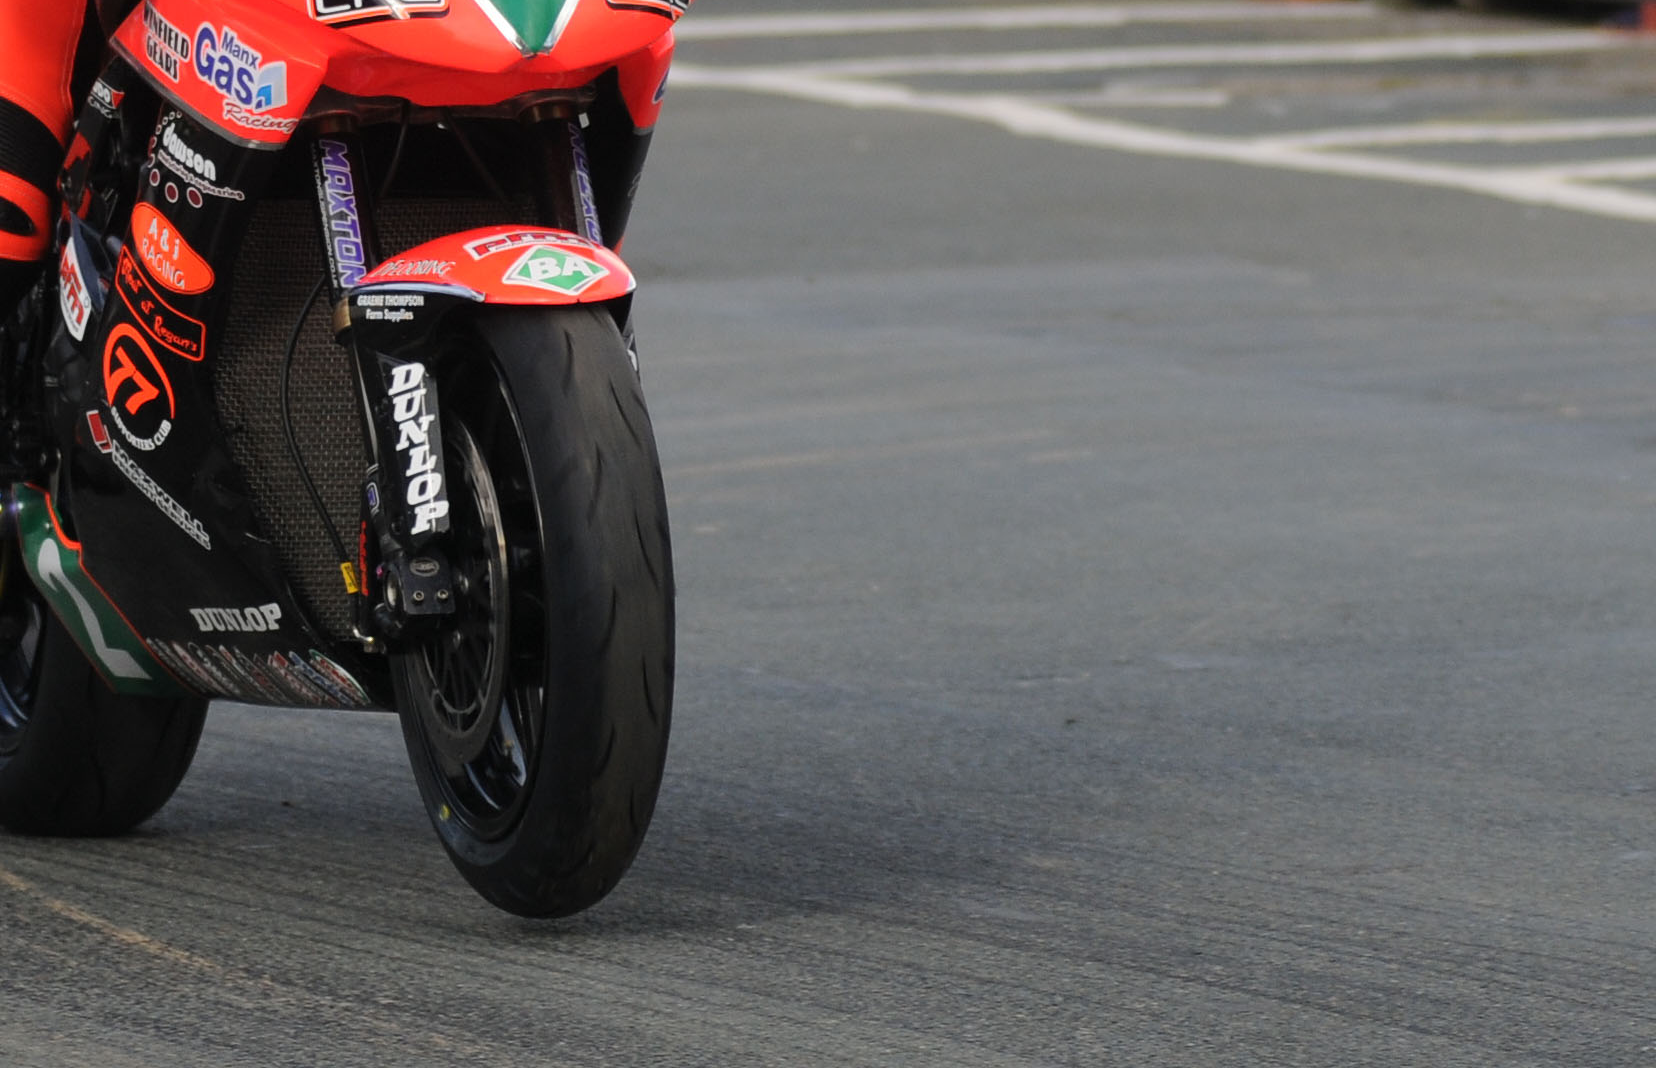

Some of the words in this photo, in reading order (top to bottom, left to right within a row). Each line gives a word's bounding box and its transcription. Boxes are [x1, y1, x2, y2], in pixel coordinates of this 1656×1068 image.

[146, 35, 178, 82] GEARS
[196, 26, 254, 106] Gas
[222, 30, 259, 69] Manx
[224, 101, 297, 133] Racing
[162, 123, 216, 181] dawson
[320, 139, 367, 288] MAXTON
[148, 217, 158, 240] A
[160, 228, 170, 251] &
[143, 238, 185, 289] RACING
[528, 257, 594, 283] BA
[384, 308, 413, 322] Supplies
[385, 295, 424, 306] THOMPSON
[154, 419, 172, 446] CLUB
[388, 362, 450, 535] DUNLOP
[190, 602, 282, 632] DUNLOP
